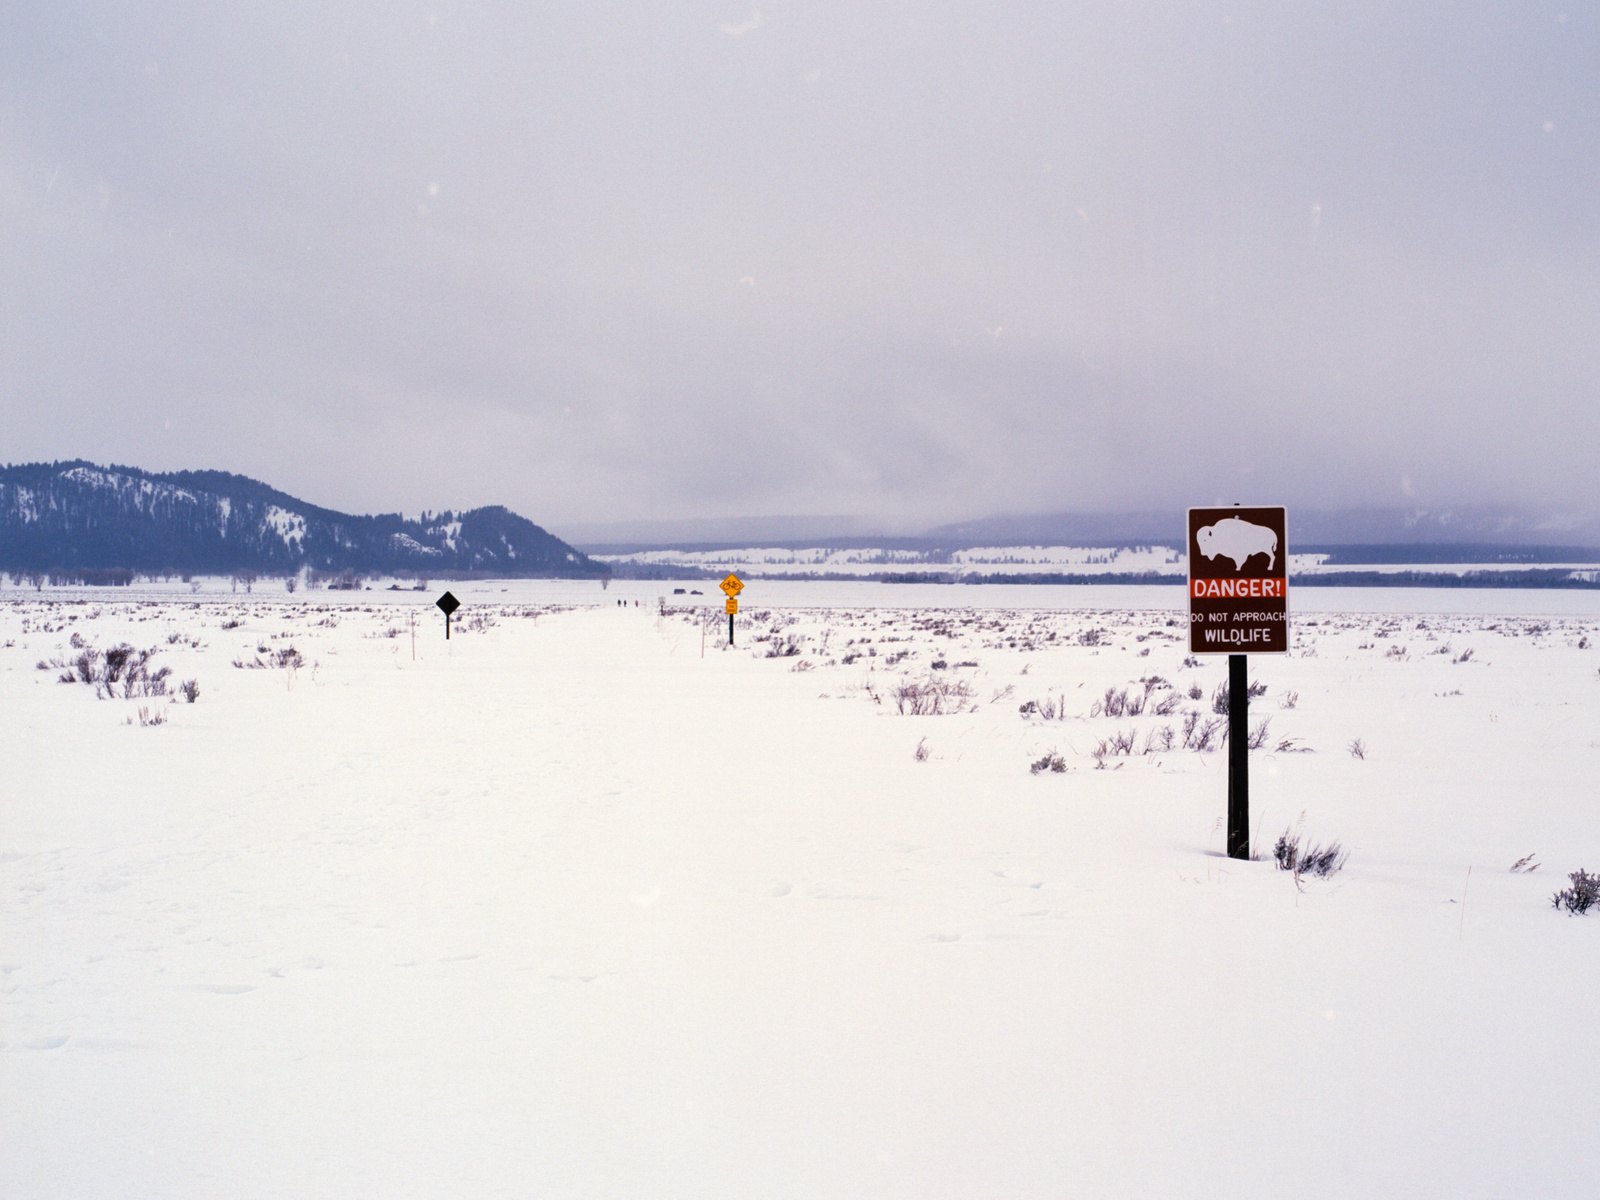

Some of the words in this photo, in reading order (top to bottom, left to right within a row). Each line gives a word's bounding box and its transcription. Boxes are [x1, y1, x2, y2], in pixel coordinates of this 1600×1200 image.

[1194, 579, 1281, 597] DANGER!
[1191, 613, 1204, 622] DO
[1208, 612, 1228, 622] NOT
[1232, 612, 1286, 622] APPROACH
[1204, 628, 1272, 643] WILDLIFE
